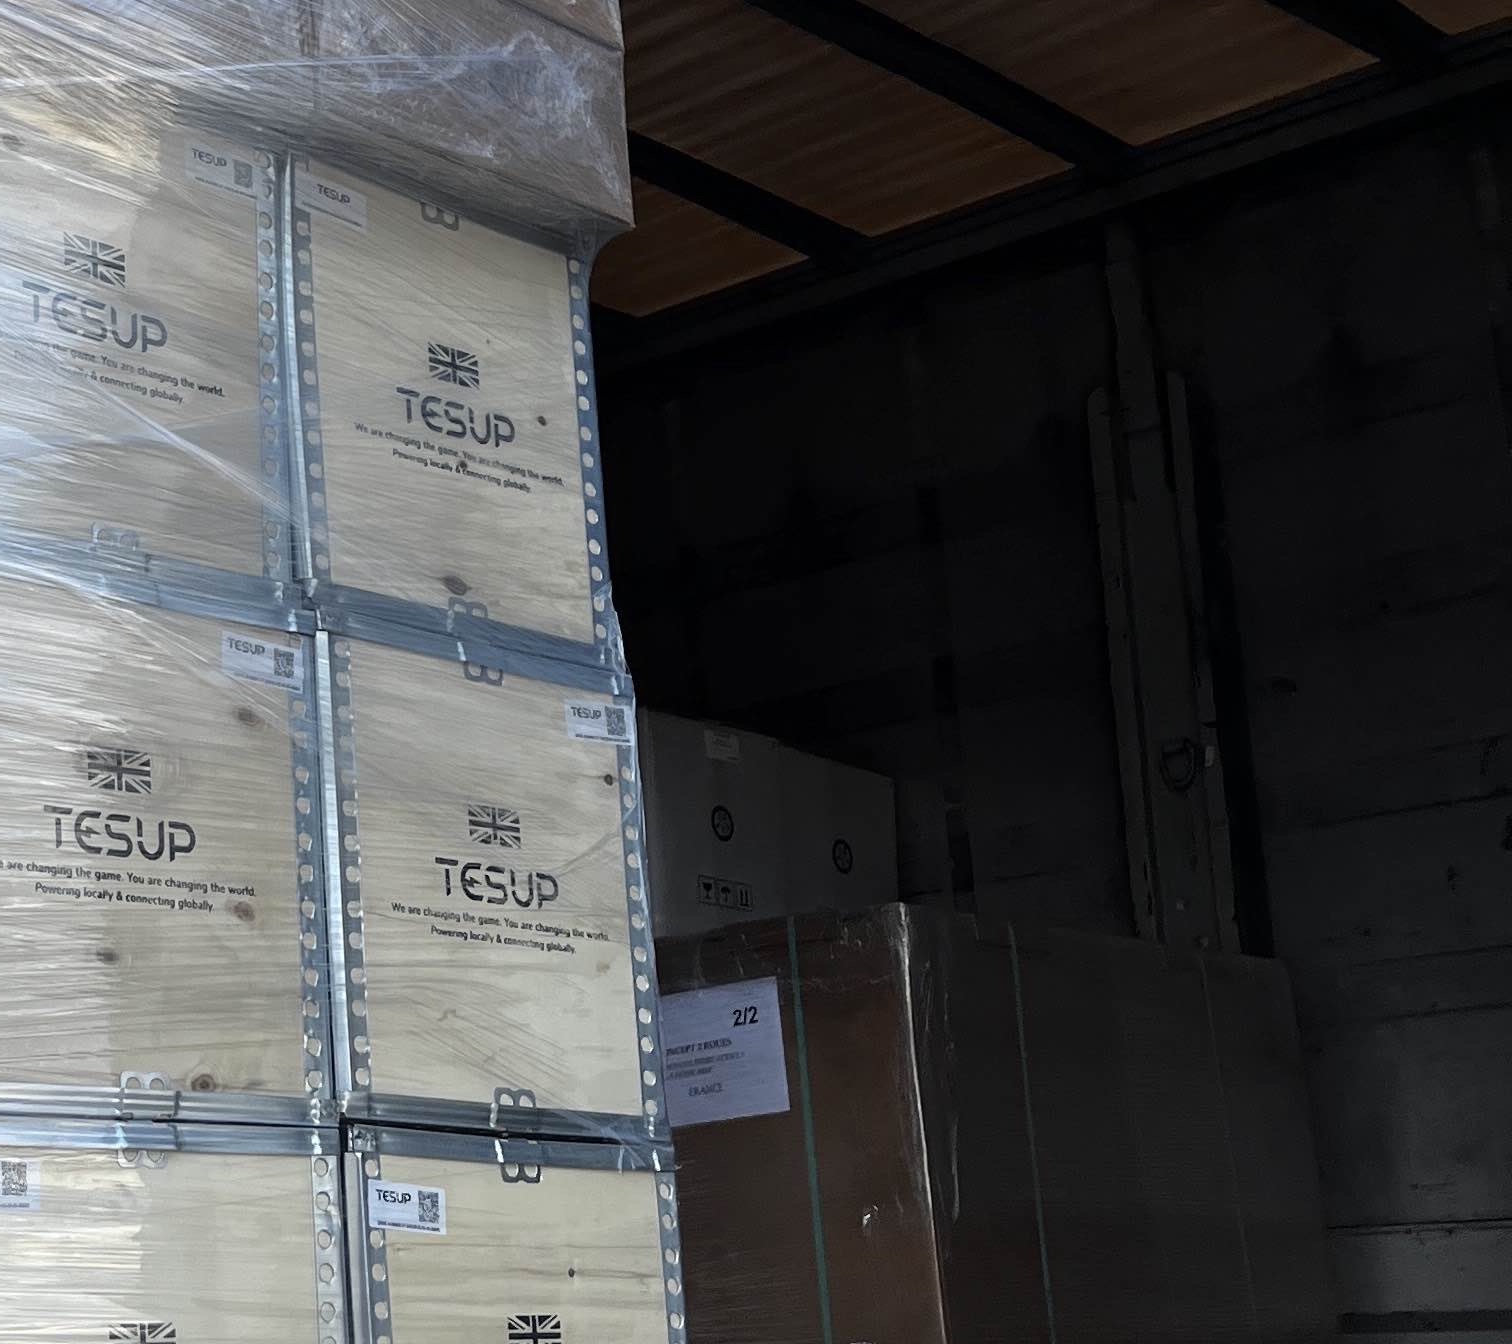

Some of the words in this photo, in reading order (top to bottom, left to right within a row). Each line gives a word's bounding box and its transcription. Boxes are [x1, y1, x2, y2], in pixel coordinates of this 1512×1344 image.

[192, 148, 227, 167] TESUP
[317, 184, 351, 204] TESUP
[22, 280, 167, 352] TESUP
[101, 355, 117, 368] You
[181, 376, 195, 389] the
[354, 423, 368, 433] We
[396, 386, 515, 448] TESUP
[227, 637, 265, 655] TESUP
[571, 706, 601, 719] TESUP
[44, 804, 196, 862] TESUP
[7, 861, 23, 871] are
[26, 862, 72, 878] changing
[76, 867, 91, 878] the
[127, 872, 144, 884] You
[147, 877, 162, 886] are
[165, 878, 208, 894] changing
[210, 883, 225, 894] the
[228, 886, 256, 897] world.
[435, 856, 558, 909] TESUP
[35, 882, 81, 898] Powering
[83, 887, 113, 902] locally
[116, 891, 122, 901] &
[126, 893, 175, 908] connecting
[178, 899, 215, 912] globally.
[392, 902, 405, 913] We
[408, 906, 421, 915] are
[423, 907, 460, 923] changing
[463, 912, 475, 923] the
[504, 917, 518, 928] You
[521, 921, 533, 930] are
[535, 923, 570, 937] changing
[572, 928, 584, 938] the
[431, 925, 468, 941] Powering
[470, 930, 494, 944] locally
[496, 934, 502, 944] &
[504, 937, 544, 951] connecting
[733, 1006, 758, 1027] 2/2
[376, 1189, 411, 1204] TESUP
